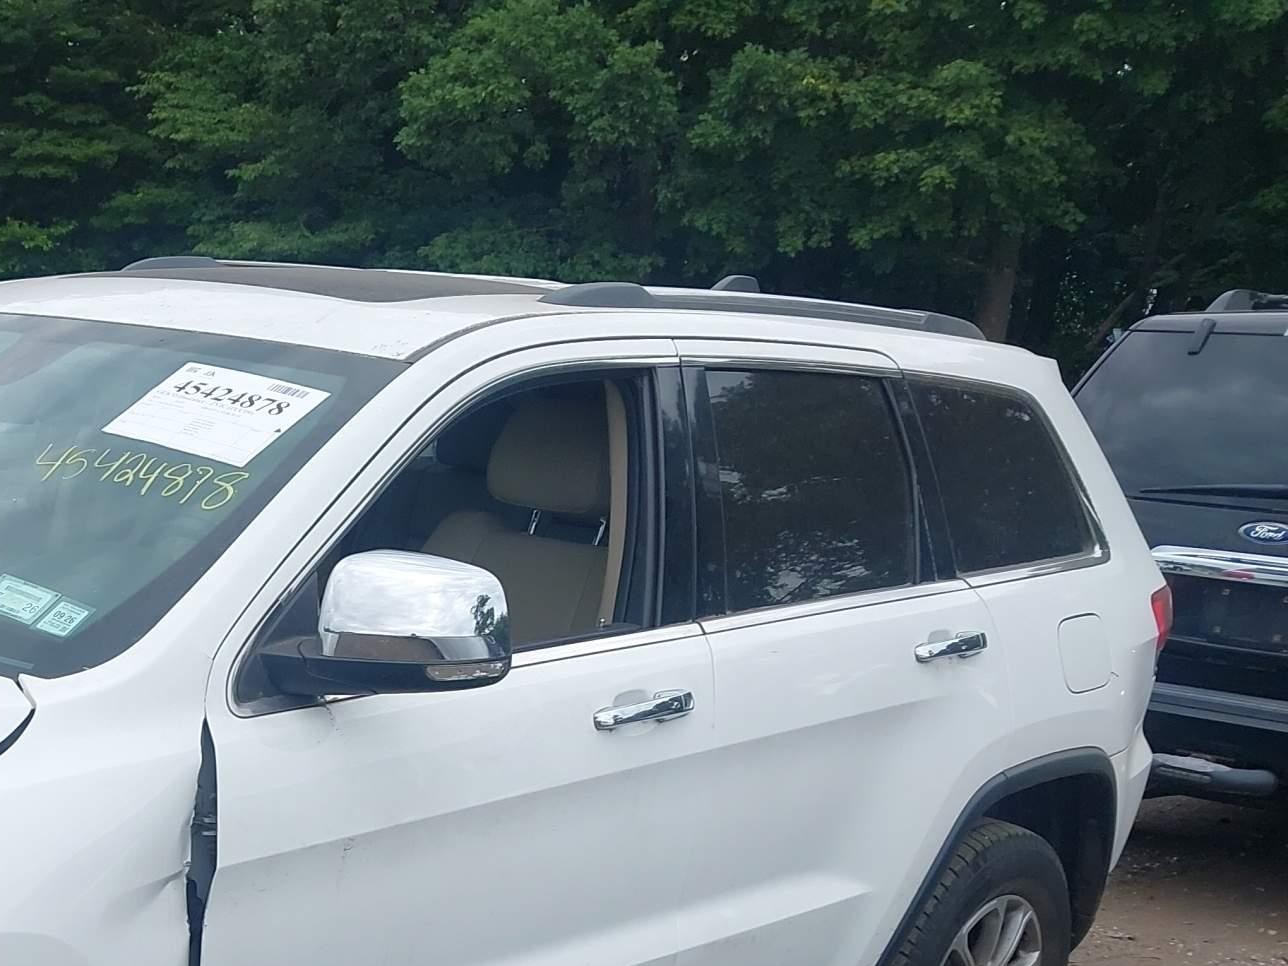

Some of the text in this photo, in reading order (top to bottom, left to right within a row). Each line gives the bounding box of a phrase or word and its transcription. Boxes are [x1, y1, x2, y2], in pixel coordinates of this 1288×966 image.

[173, 379, 290, 416] 45424878
[36, 444, 249, 509] 45424878
[1250, 525, 1287, 541] Ford
